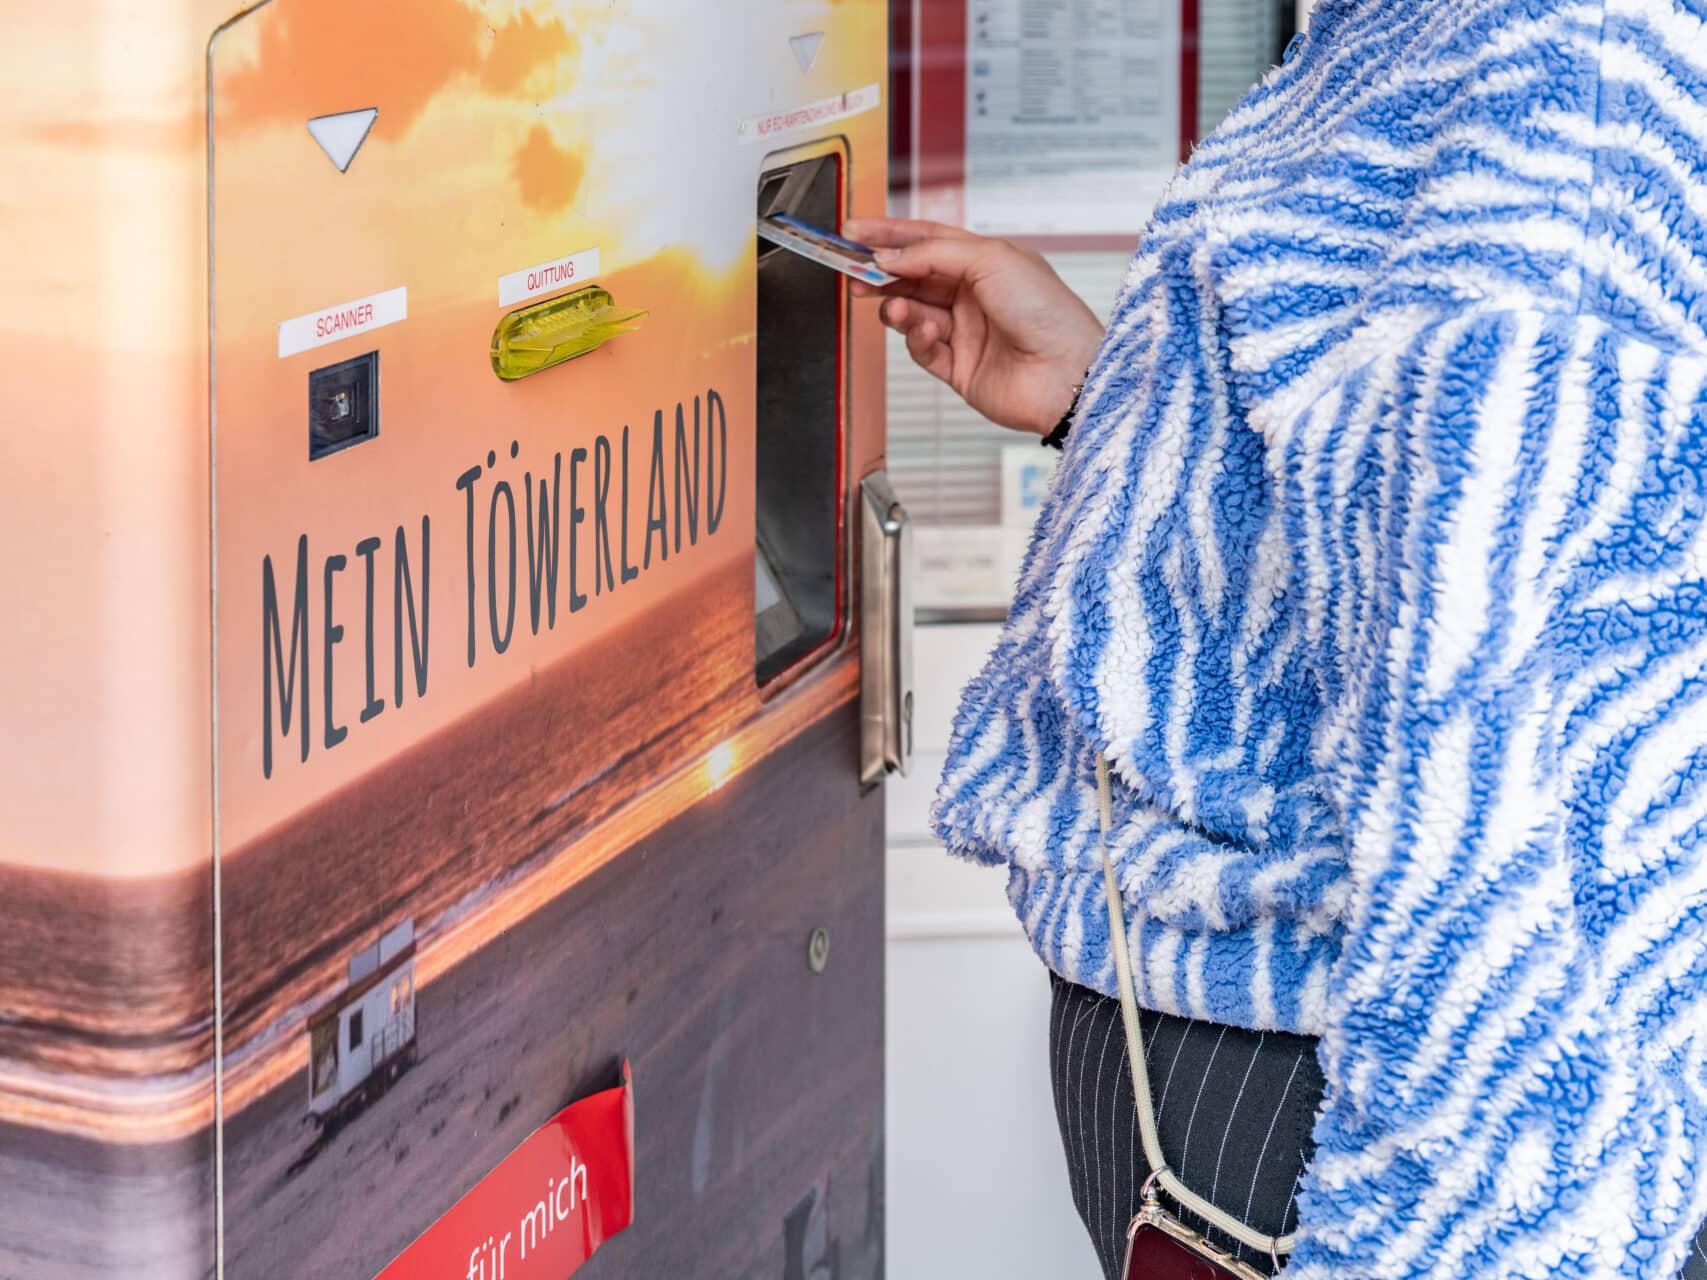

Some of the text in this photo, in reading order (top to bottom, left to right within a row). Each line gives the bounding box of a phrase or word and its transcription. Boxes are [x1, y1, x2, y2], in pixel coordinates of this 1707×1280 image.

[527, 261, 575, 291] QUITTUNG
[316, 303, 374, 338] SCANNER
[456, 388, 727, 669] TÖWERLAND
[466, 1155, 587, 1280] für mich
